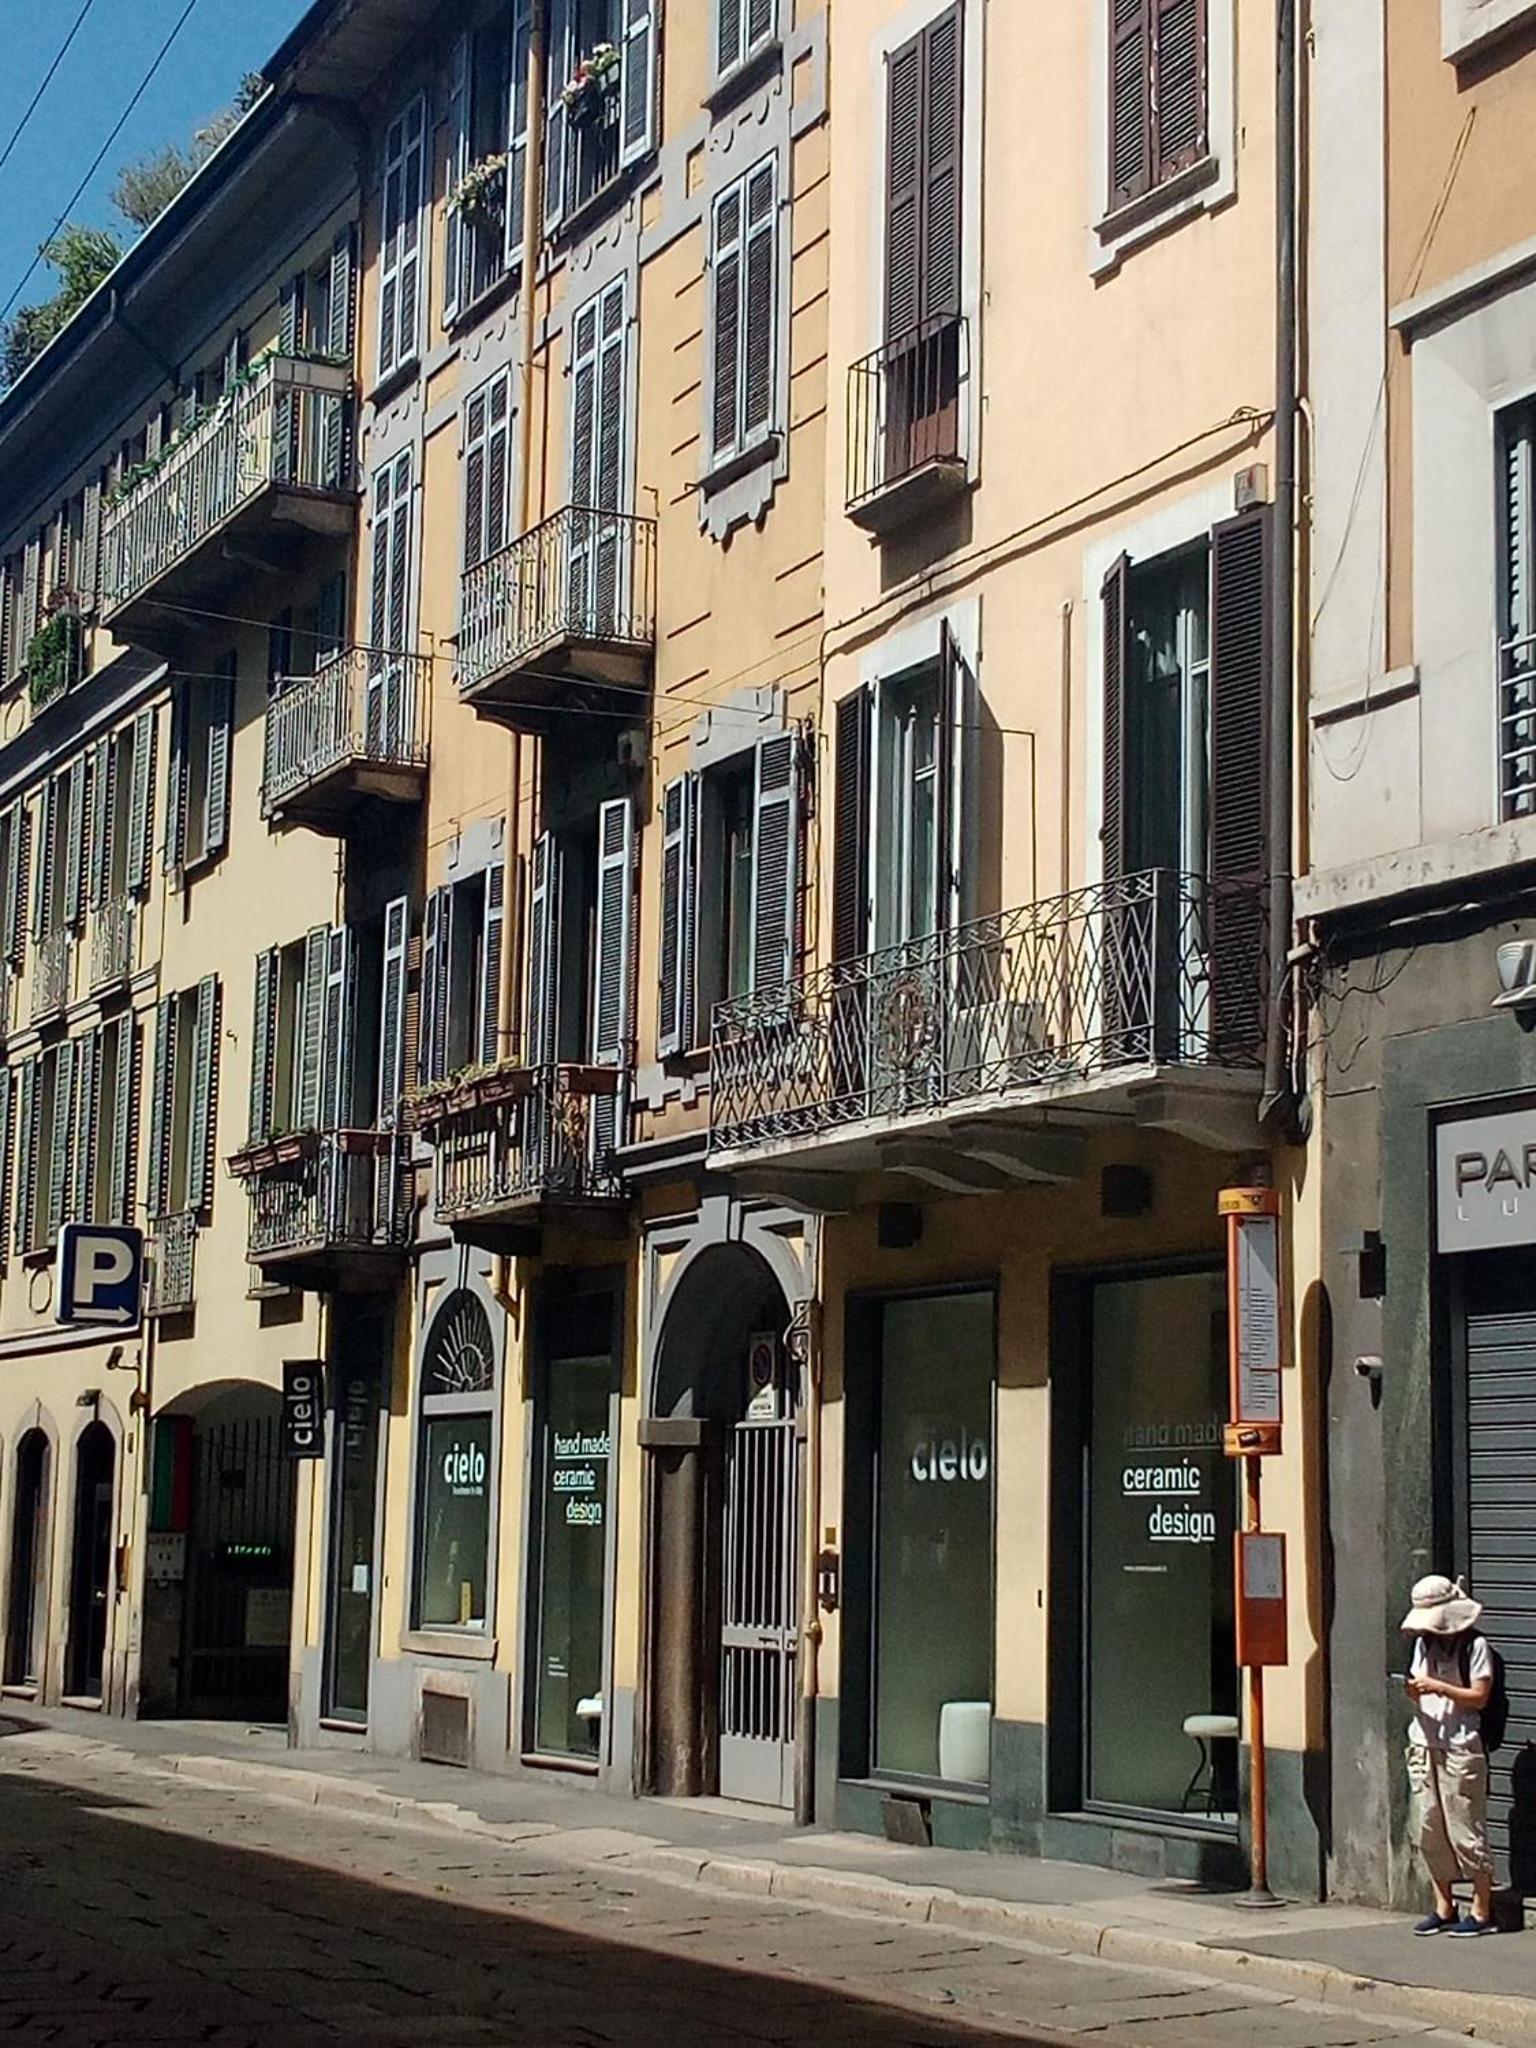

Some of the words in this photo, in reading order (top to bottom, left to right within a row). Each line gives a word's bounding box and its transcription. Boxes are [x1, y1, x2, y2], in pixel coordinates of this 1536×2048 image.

[73, 1236, 134, 1303] P
[286, 1377, 313, 1446] cielo
[554, 1431, 580, 1454] hand
[582, 1430, 610, 1453] made
[912, 1426, 987, 1480] cielo
[444, 1442, 486, 1484] cielo
[553, 1463, 596, 1486] ceramic
[1123, 1458, 1200, 1490] ceramic
[566, 1496, 602, 1525] design
[1149, 1504, 1216, 1543] design
